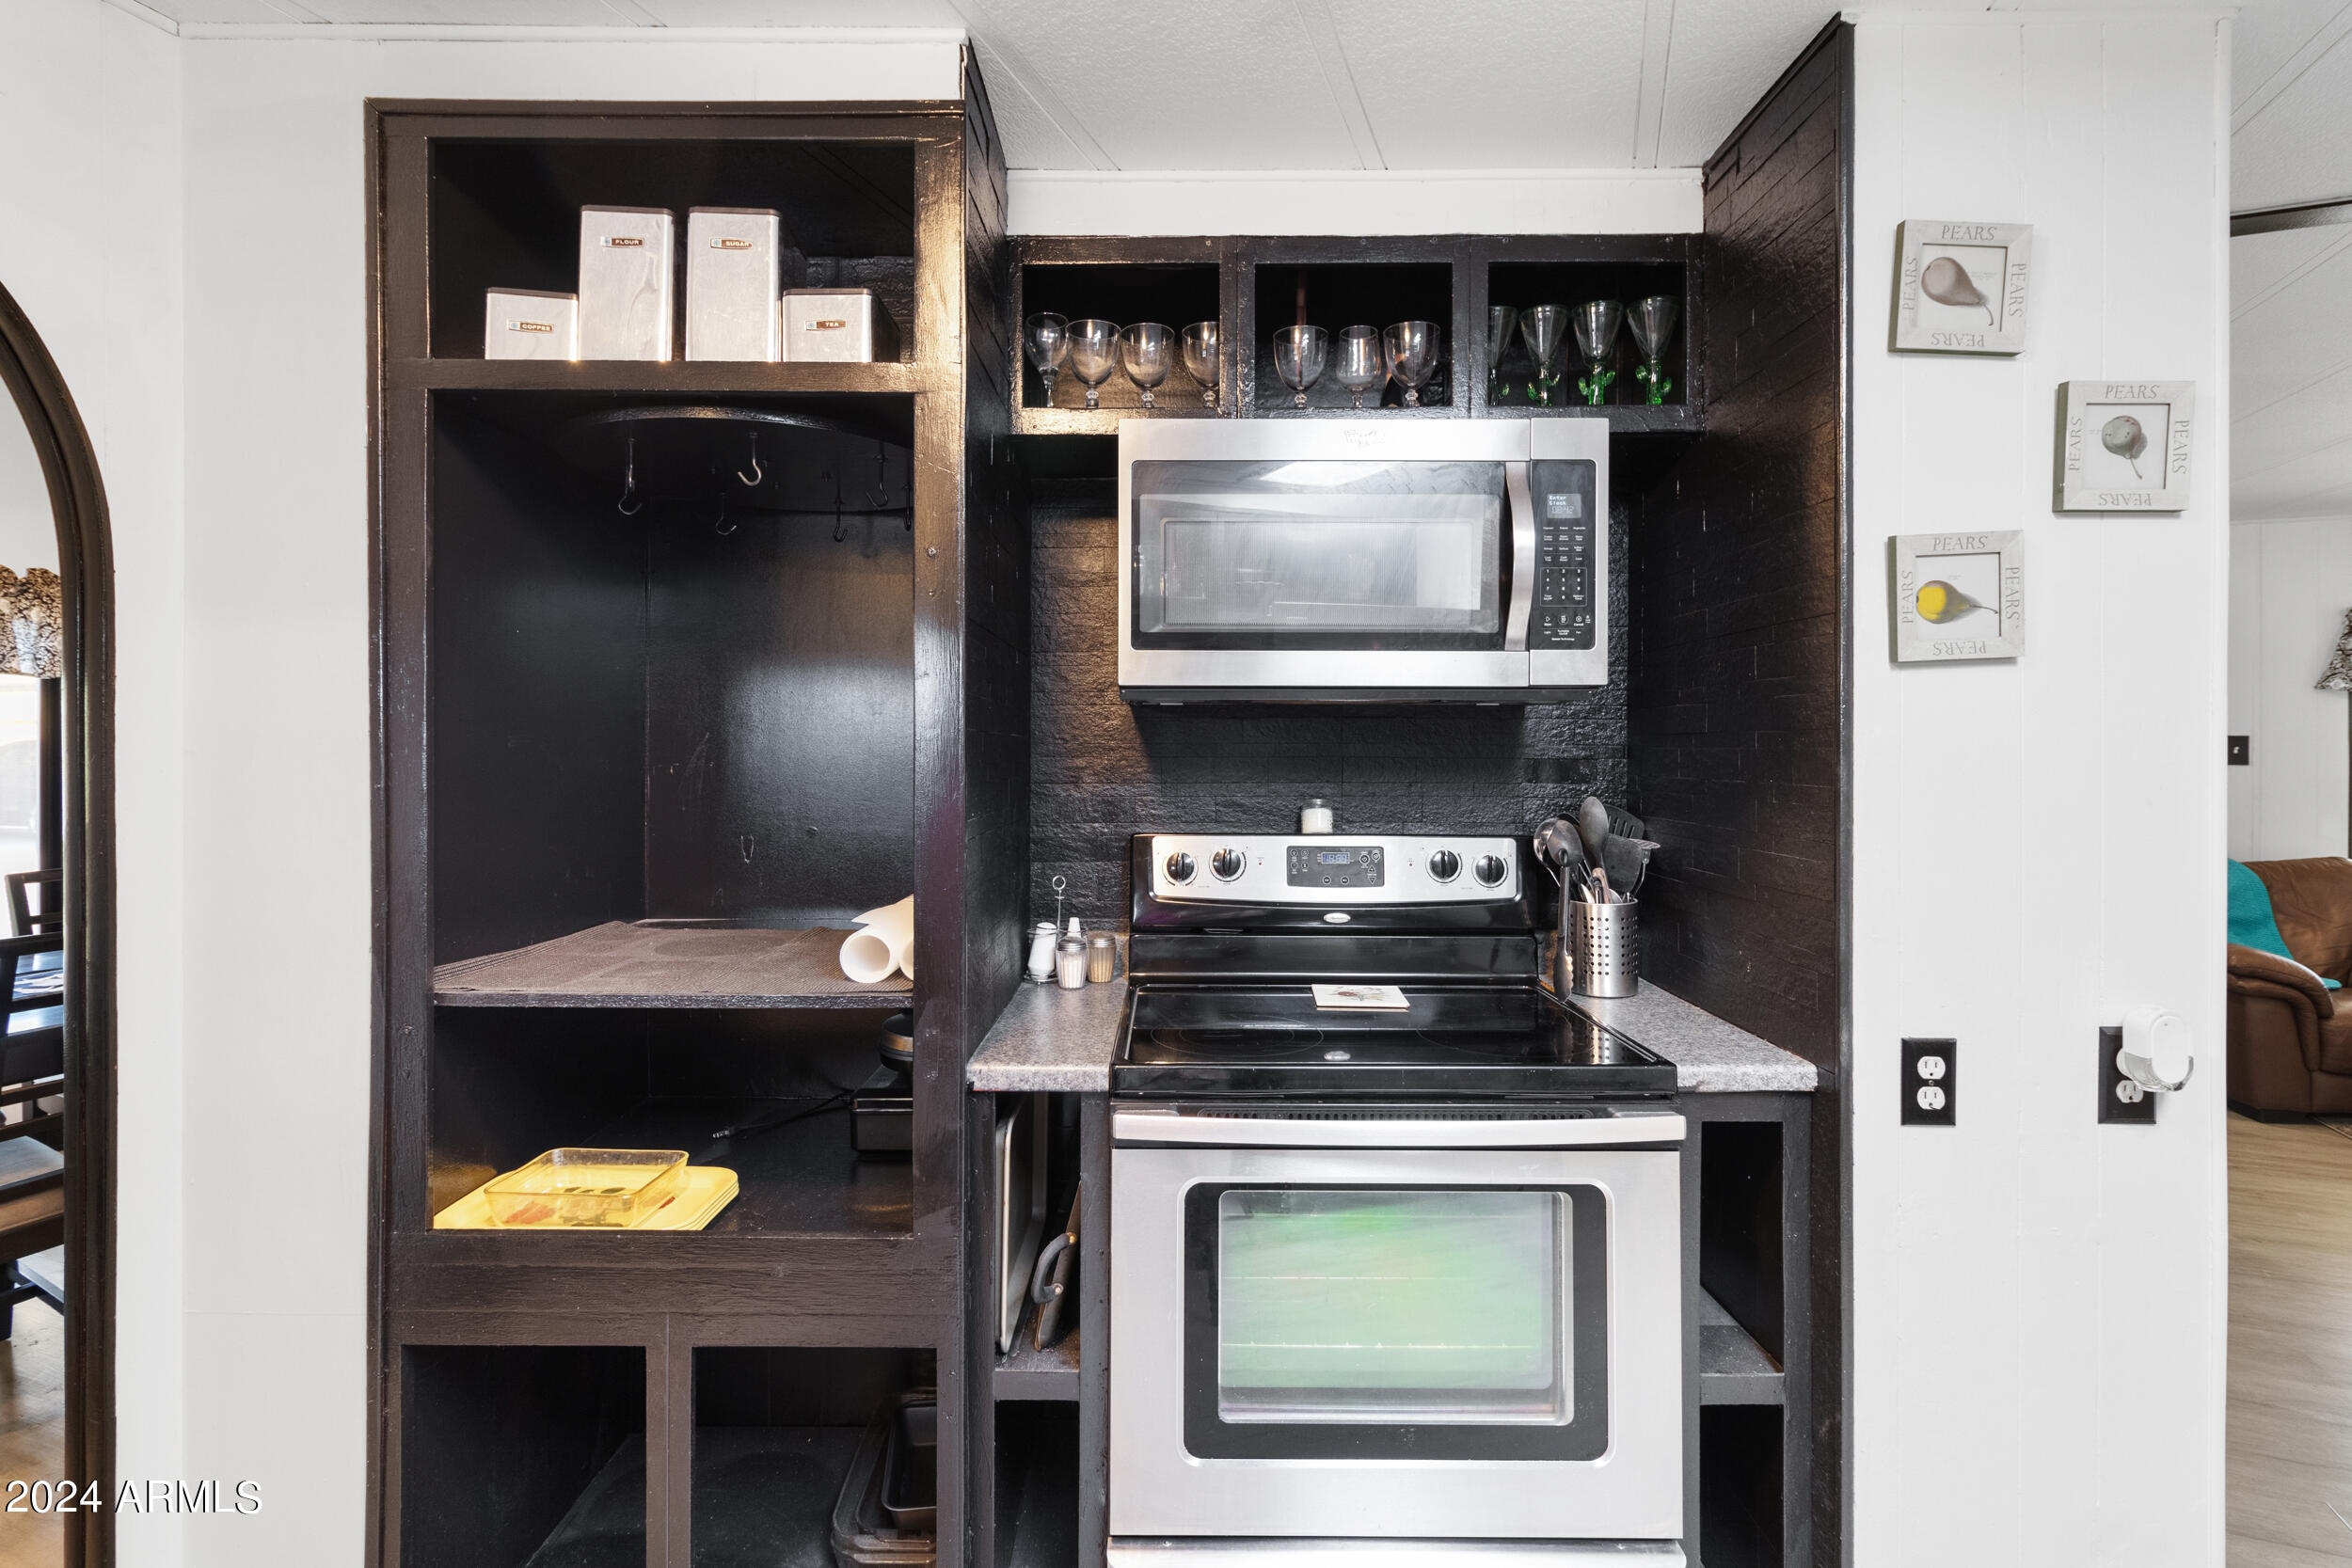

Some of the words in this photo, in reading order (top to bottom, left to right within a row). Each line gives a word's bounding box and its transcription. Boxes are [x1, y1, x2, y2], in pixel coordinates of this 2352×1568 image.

[1941, 225, 1997, 241] PEARS
[1902, 256, 1917, 311] PEARS
[2008, 262, 2027, 318] PEARS
[1931, 332, 1985, 347] PEARS
[2105, 384, 2160, 400] PEARS
[2069, 416, 2082, 471] PEARS
[2171, 420, 2190, 475] PEARS
[2099, 493, 2153, 506] PEARS
[1933, 535, 1988, 551] PEARS
[1901, 570, 1914, 624] PEARS
[2005, 566, 2021, 621] PEARS
[1932, 641, 1987, 656] PEARS
